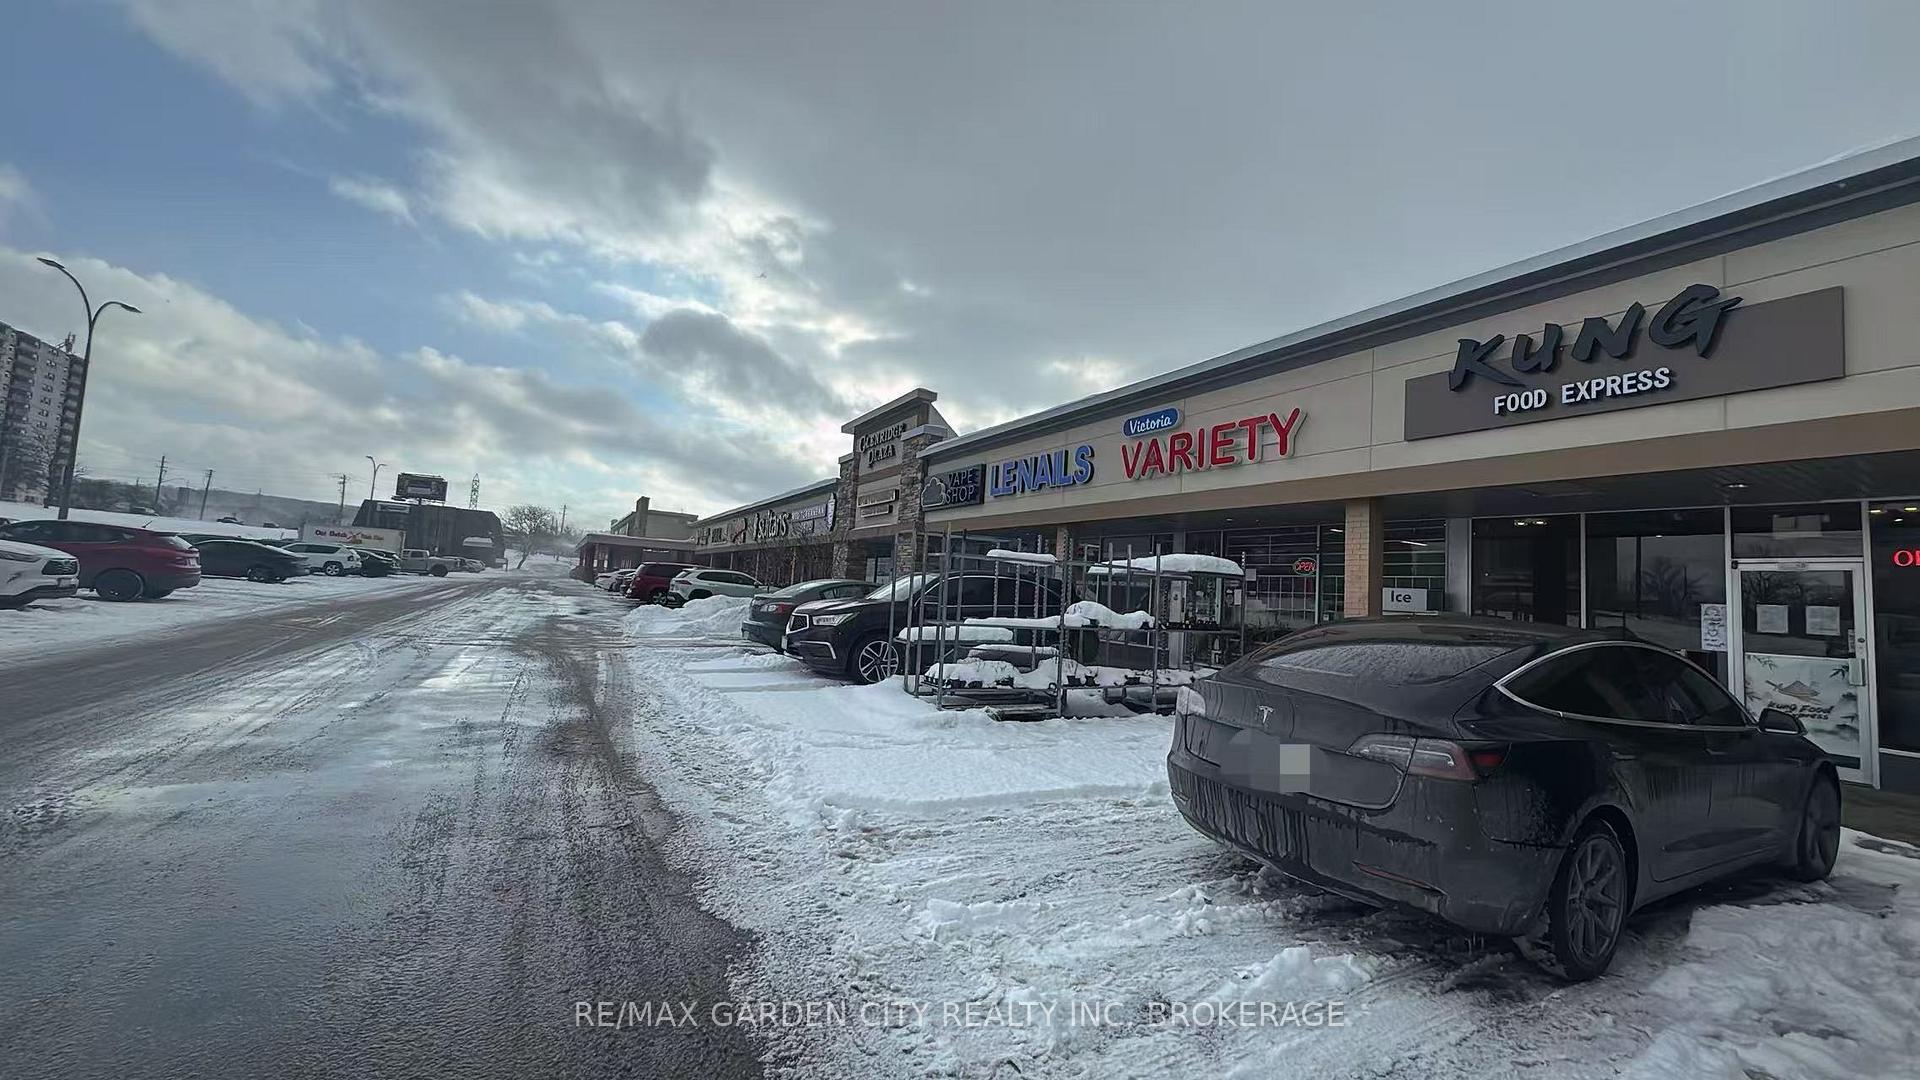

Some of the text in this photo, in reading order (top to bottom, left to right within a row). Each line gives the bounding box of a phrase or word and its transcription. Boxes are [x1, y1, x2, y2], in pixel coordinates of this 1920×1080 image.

[1450, 285, 1743, 391] KUNG
[1494, 367, 1672, 415] FOOD EXPRESS
[1129, 415, 1173, 434] Victoria
[1120, 407, 1301, 479] VARIETY
[948, 468, 974, 487] VAPE
[945, 485, 975, 504] SHOP
[1295, 557, 1316, 571] OPEN
[1391, 590, 1411, 603] Ice
